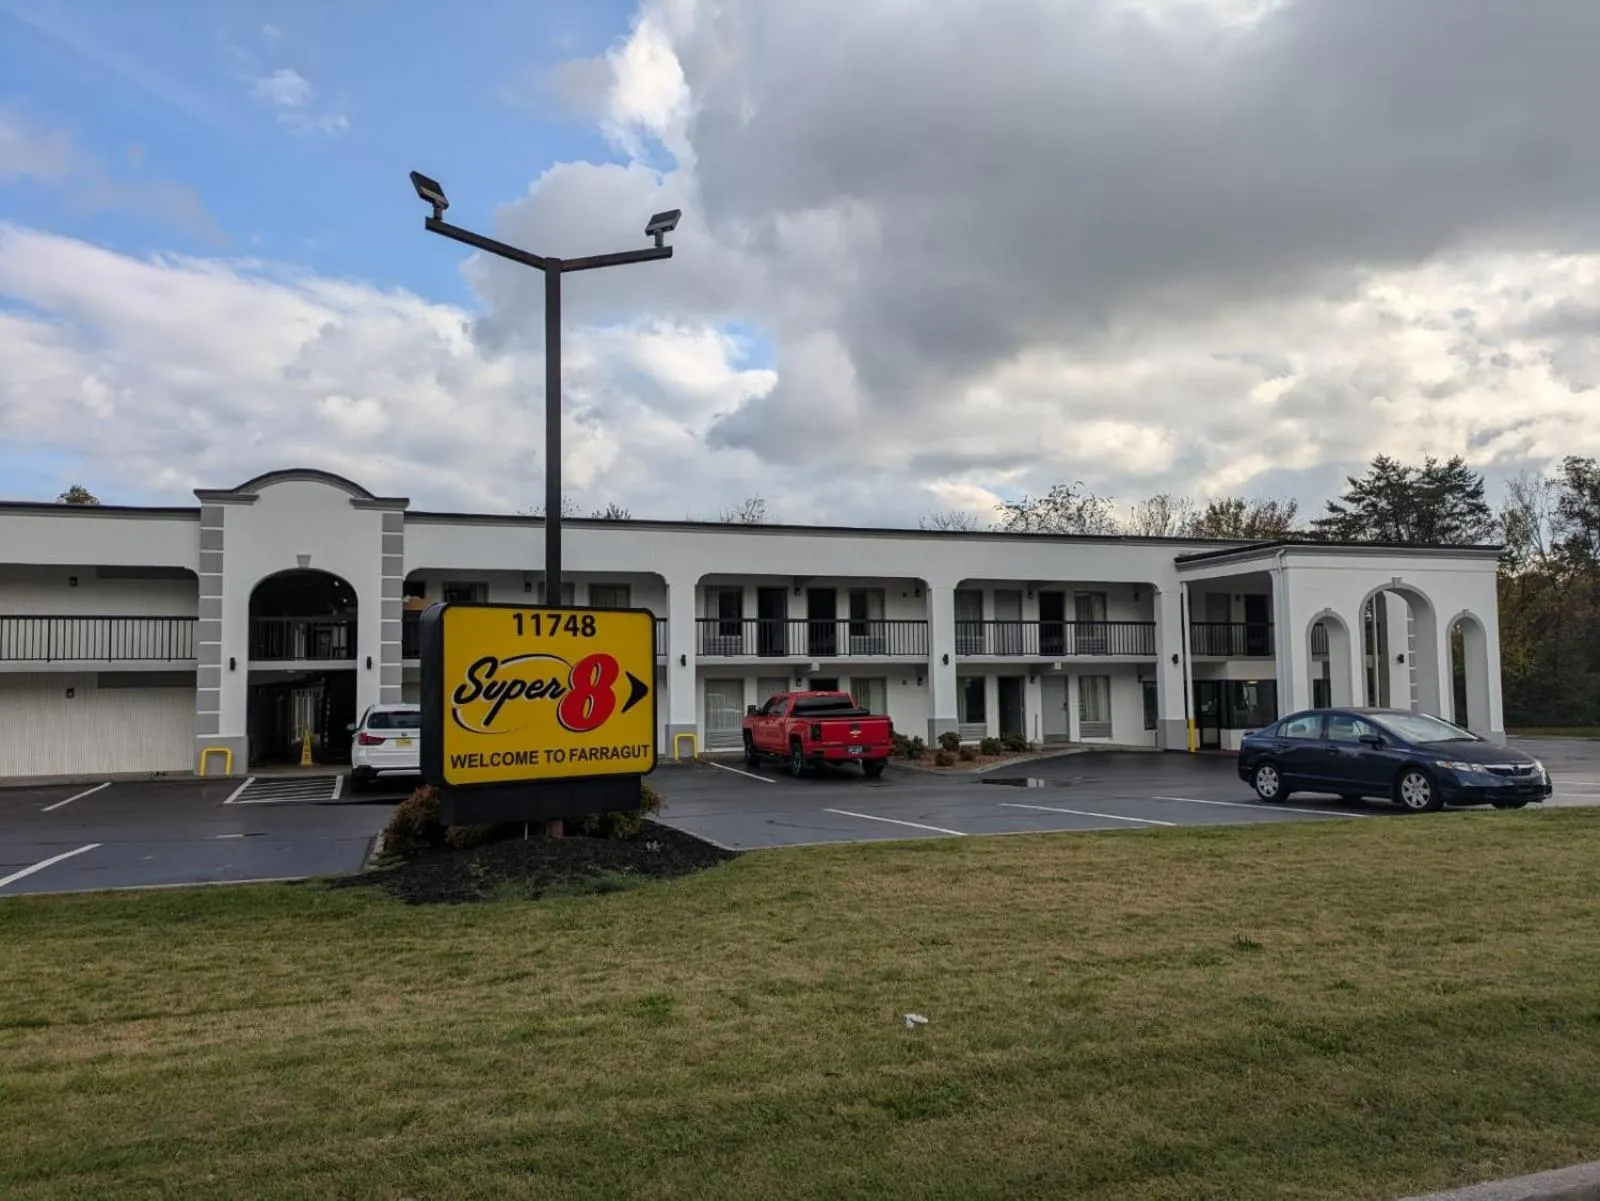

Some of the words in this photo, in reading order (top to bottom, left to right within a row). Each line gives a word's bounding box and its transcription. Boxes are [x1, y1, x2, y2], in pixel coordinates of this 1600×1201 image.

[513, 612, 597, 638] 11748
[453, 655, 567, 728] Super
[556, 653, 619, 733] 8
[451, 750, 539, 769] WELCOME
[544, 749, 565, 764] TO
[569, 744, 650, 762] FARRAGUT
